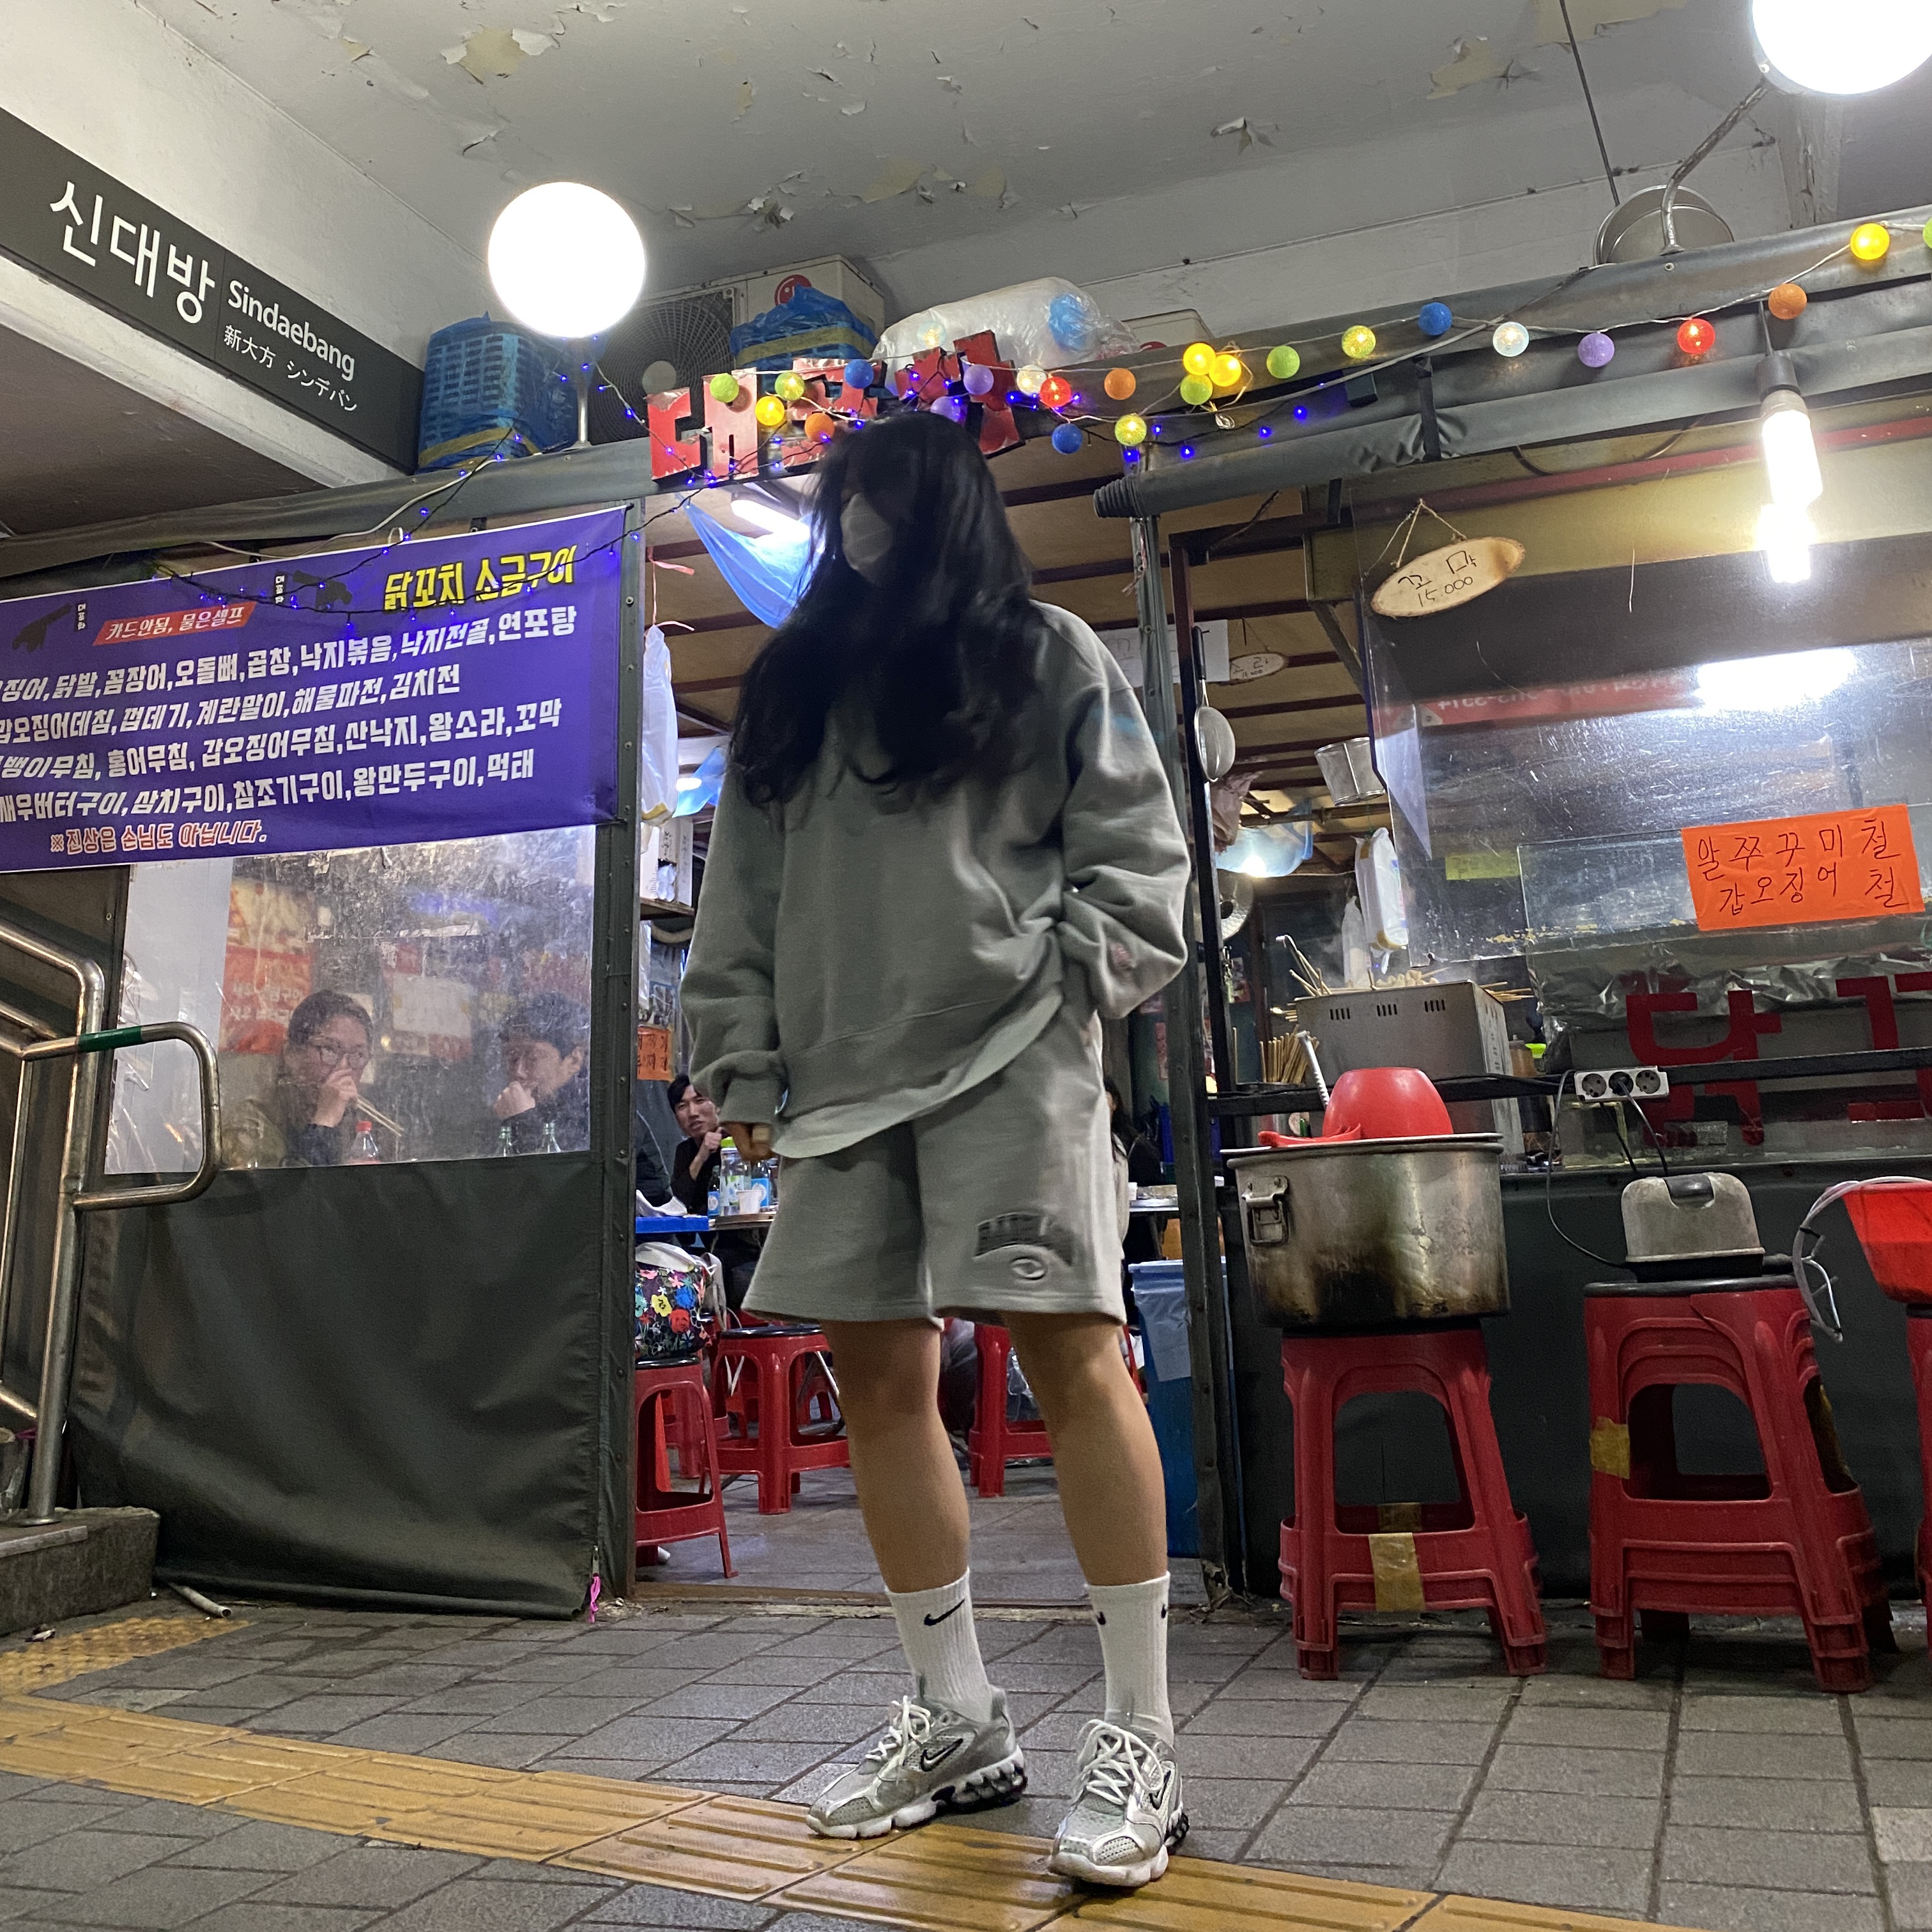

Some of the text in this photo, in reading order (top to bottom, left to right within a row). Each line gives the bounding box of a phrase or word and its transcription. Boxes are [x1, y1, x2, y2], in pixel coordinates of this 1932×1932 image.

[50, 181, 215, 323] 신대방
[227, 280, 355, 381] Sindaebang
[224, 324, 357, 411] 新大方 シンデバン
[384, 545, 577, 611] 닭꼬치 소금구이
[0, 677, 50, 702] 징어,
[0, 753, 101, 781] 뱅이무침,
[121, 823, 174, 852] 손님도
[180, 820, 267, 848] 아닙니다.
